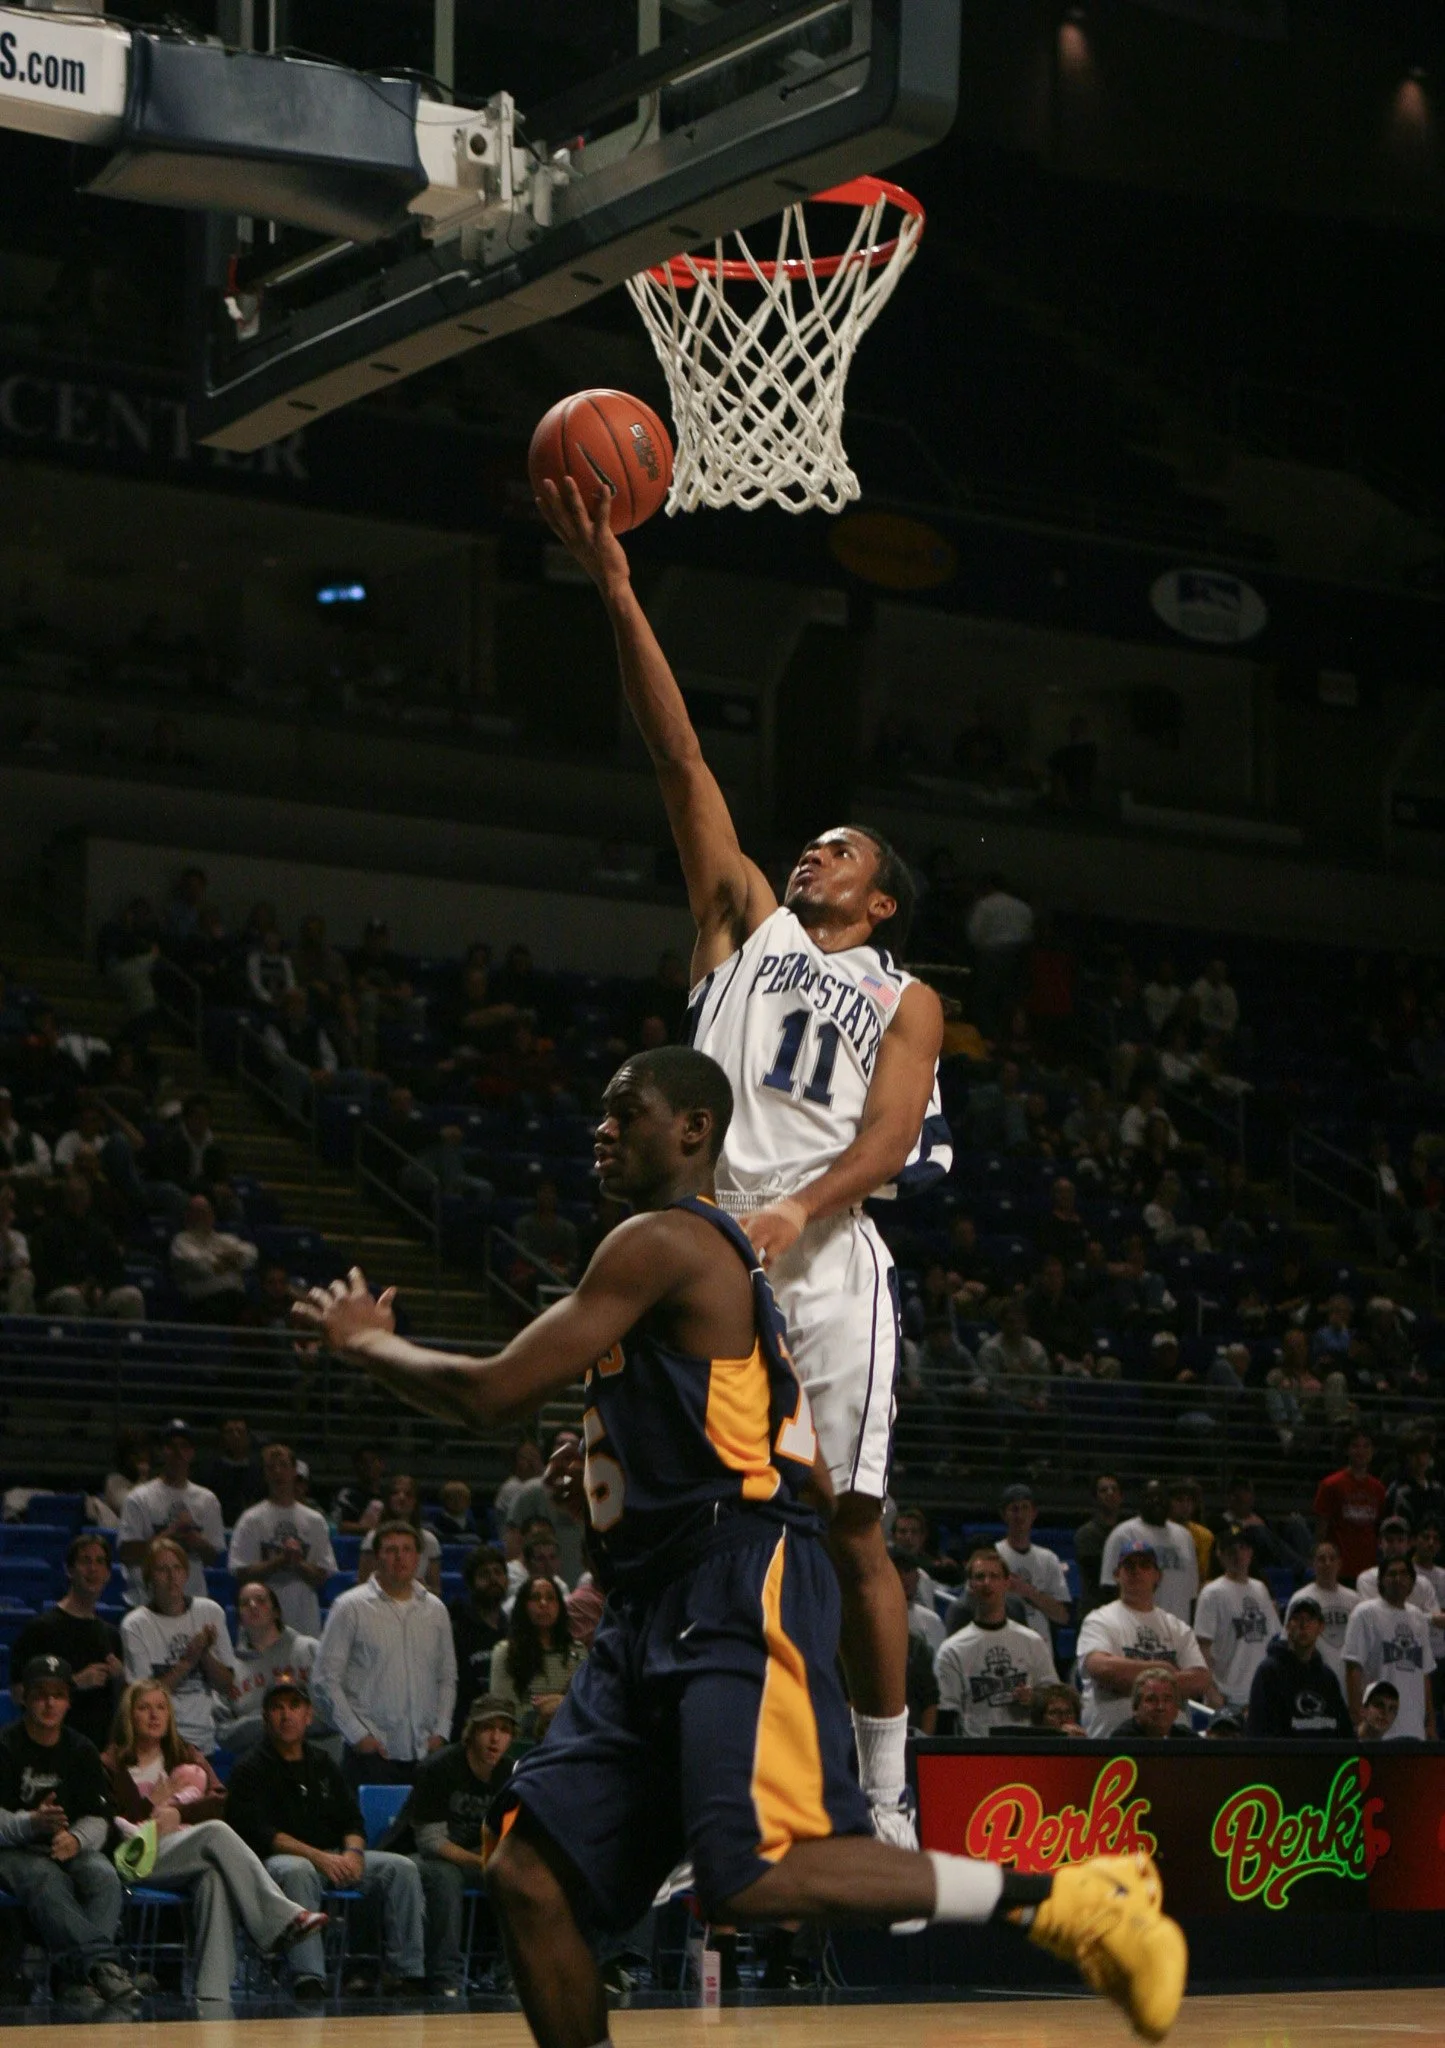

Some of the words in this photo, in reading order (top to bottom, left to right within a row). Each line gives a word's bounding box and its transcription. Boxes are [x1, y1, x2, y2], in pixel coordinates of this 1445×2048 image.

[0, 32, 85, 94] S.com
[748, 952, 819, 998] PENN
[813, 974, 881, 1079] STATE
[757, 1009, 835, 1112] 11
[1212, 1757, 1391, 1909] Berks
